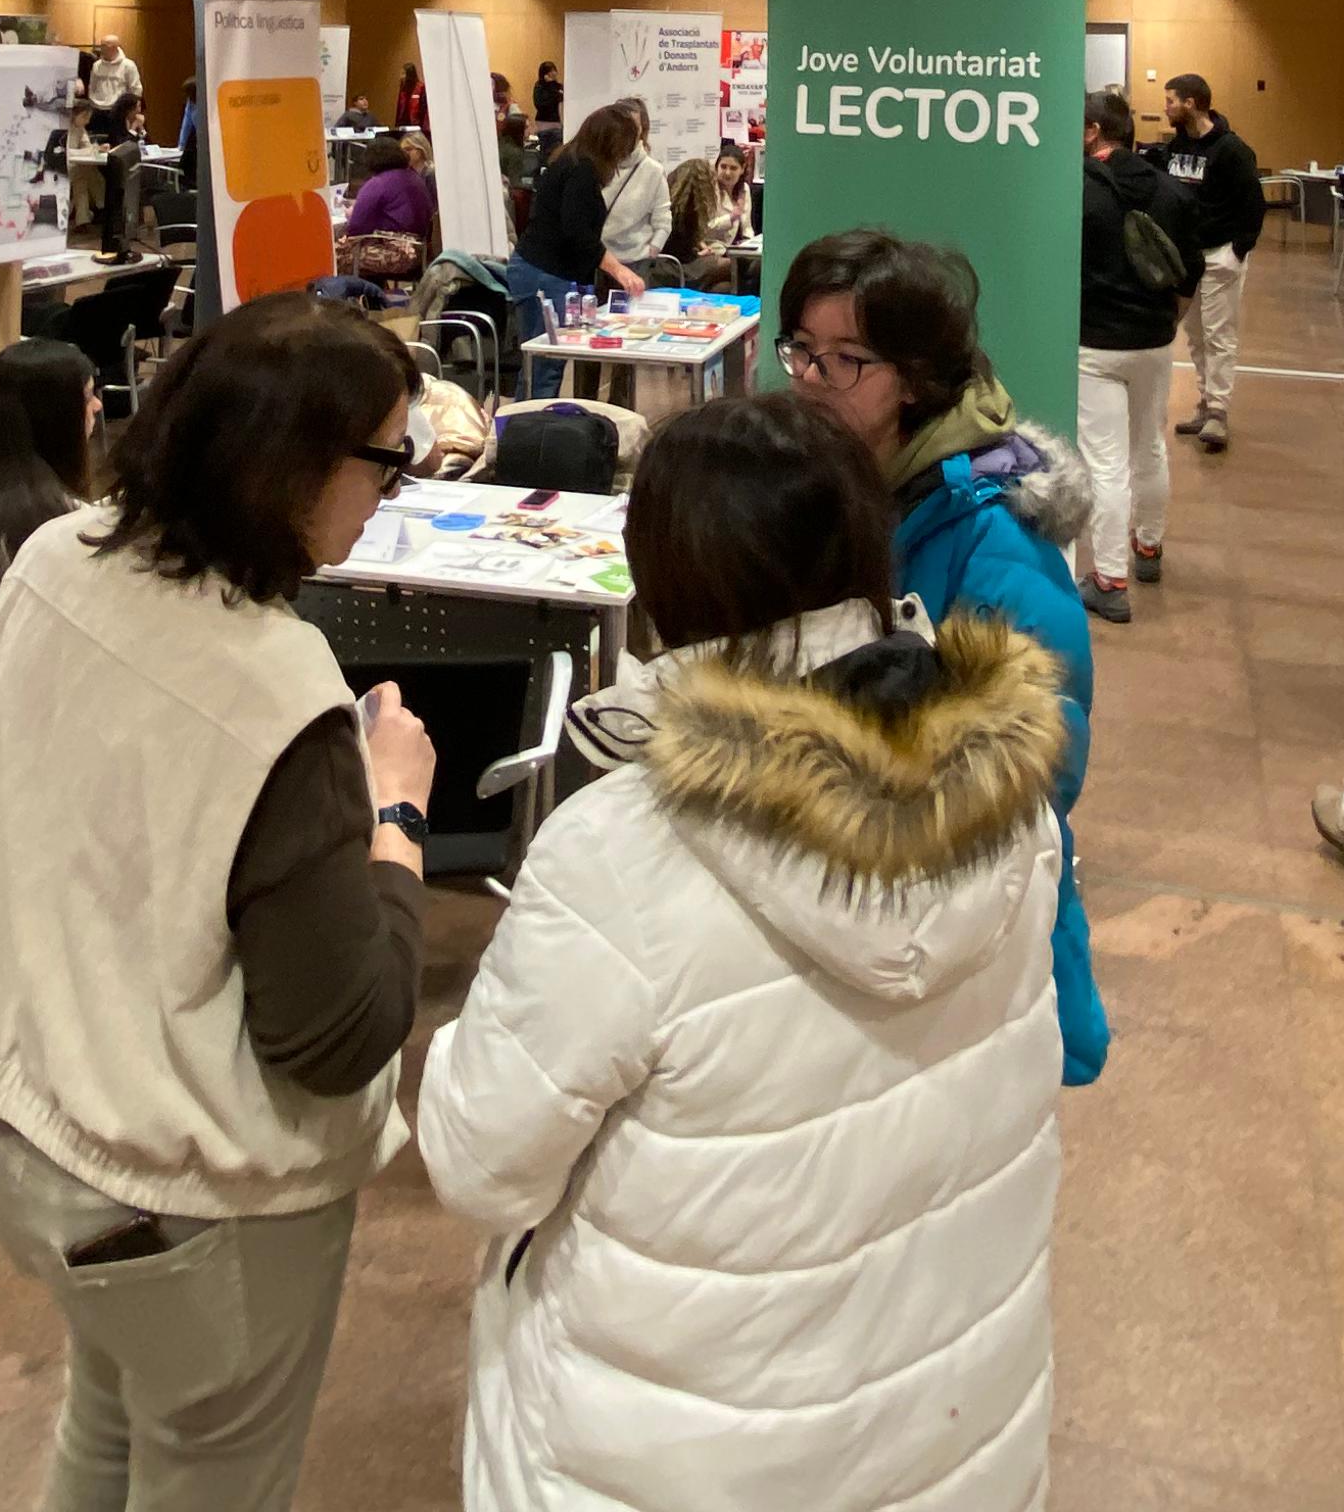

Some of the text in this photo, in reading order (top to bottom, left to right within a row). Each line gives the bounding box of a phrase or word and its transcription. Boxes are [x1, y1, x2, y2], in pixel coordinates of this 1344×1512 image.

[797, 45, 1041, 78] Jove Voluntariat
[796, 84, 1040, 147] LECTOR
